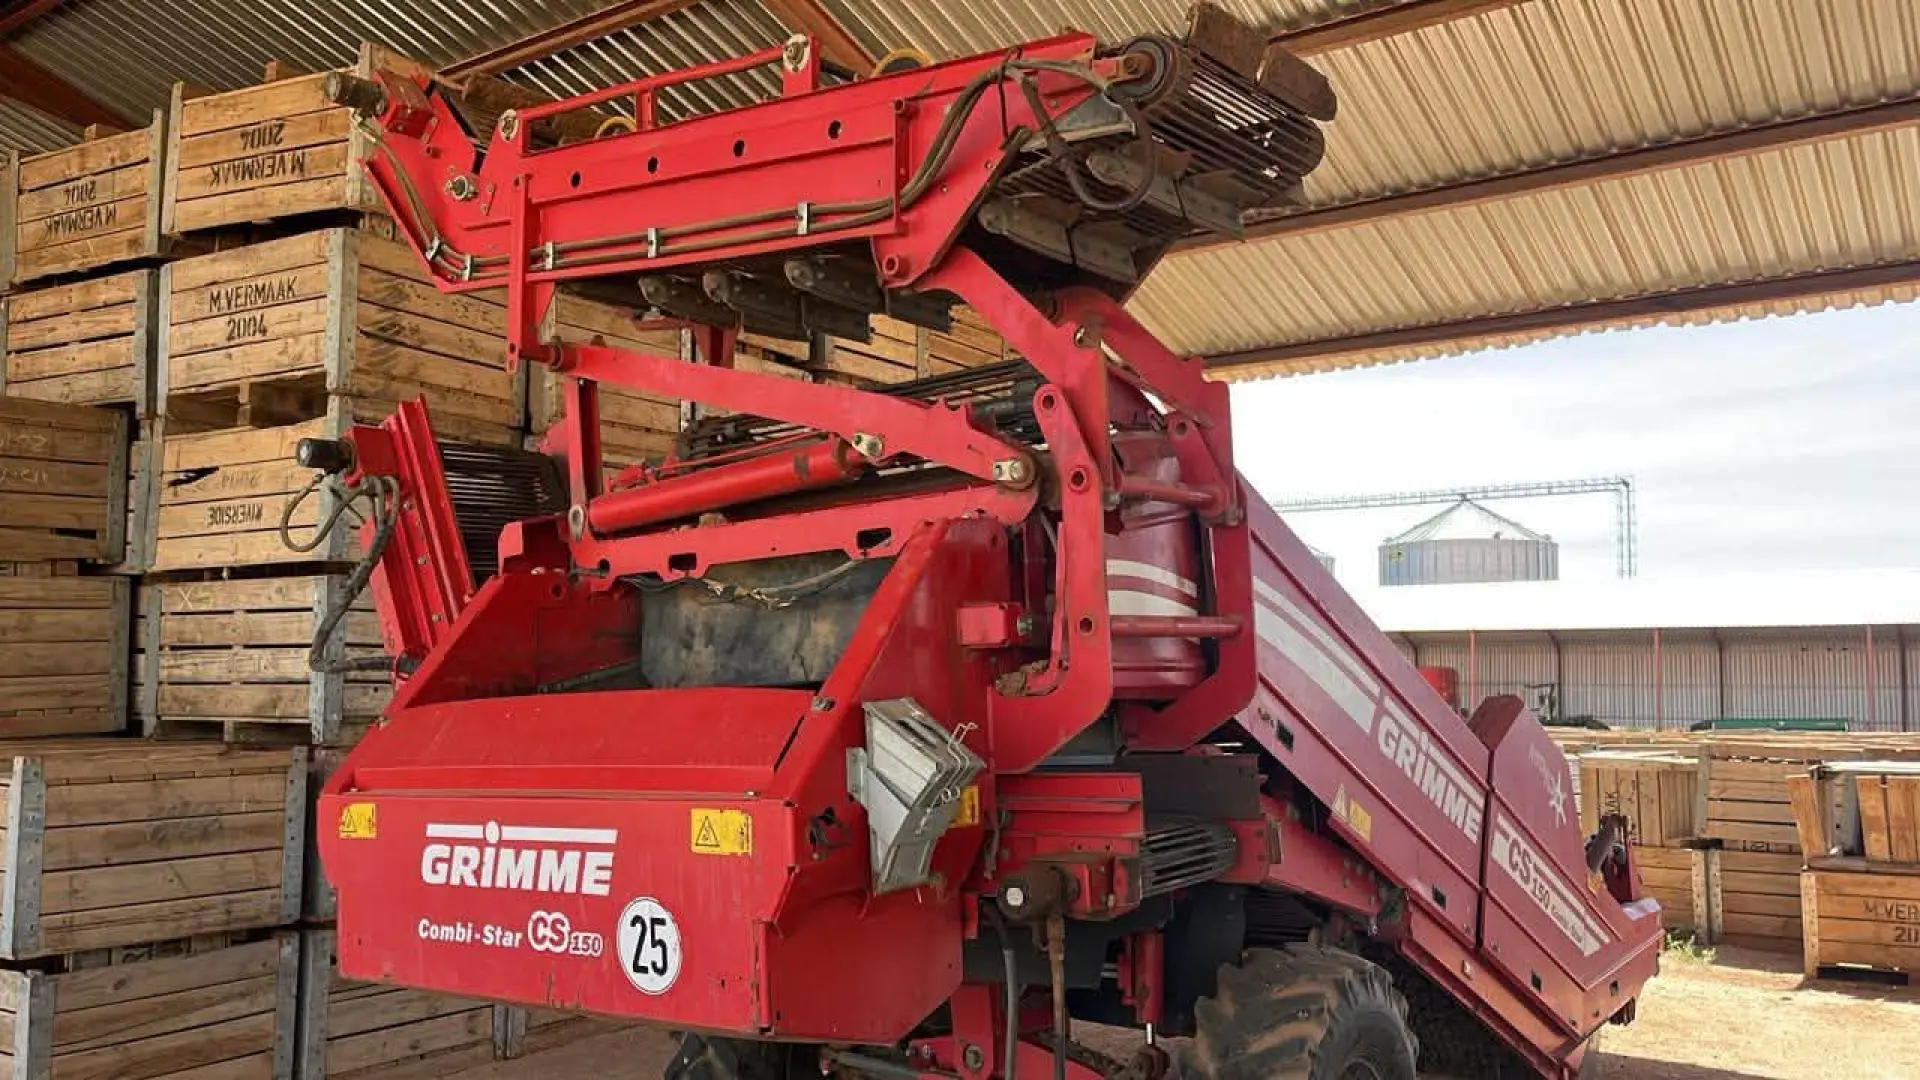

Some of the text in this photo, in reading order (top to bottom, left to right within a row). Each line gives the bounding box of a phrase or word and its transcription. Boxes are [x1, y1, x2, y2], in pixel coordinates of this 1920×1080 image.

[1378, 714, 1483, 844] GRIMME
[421, 820, 616, 896] GRIMME
[629, 914, 669, 977] 25
